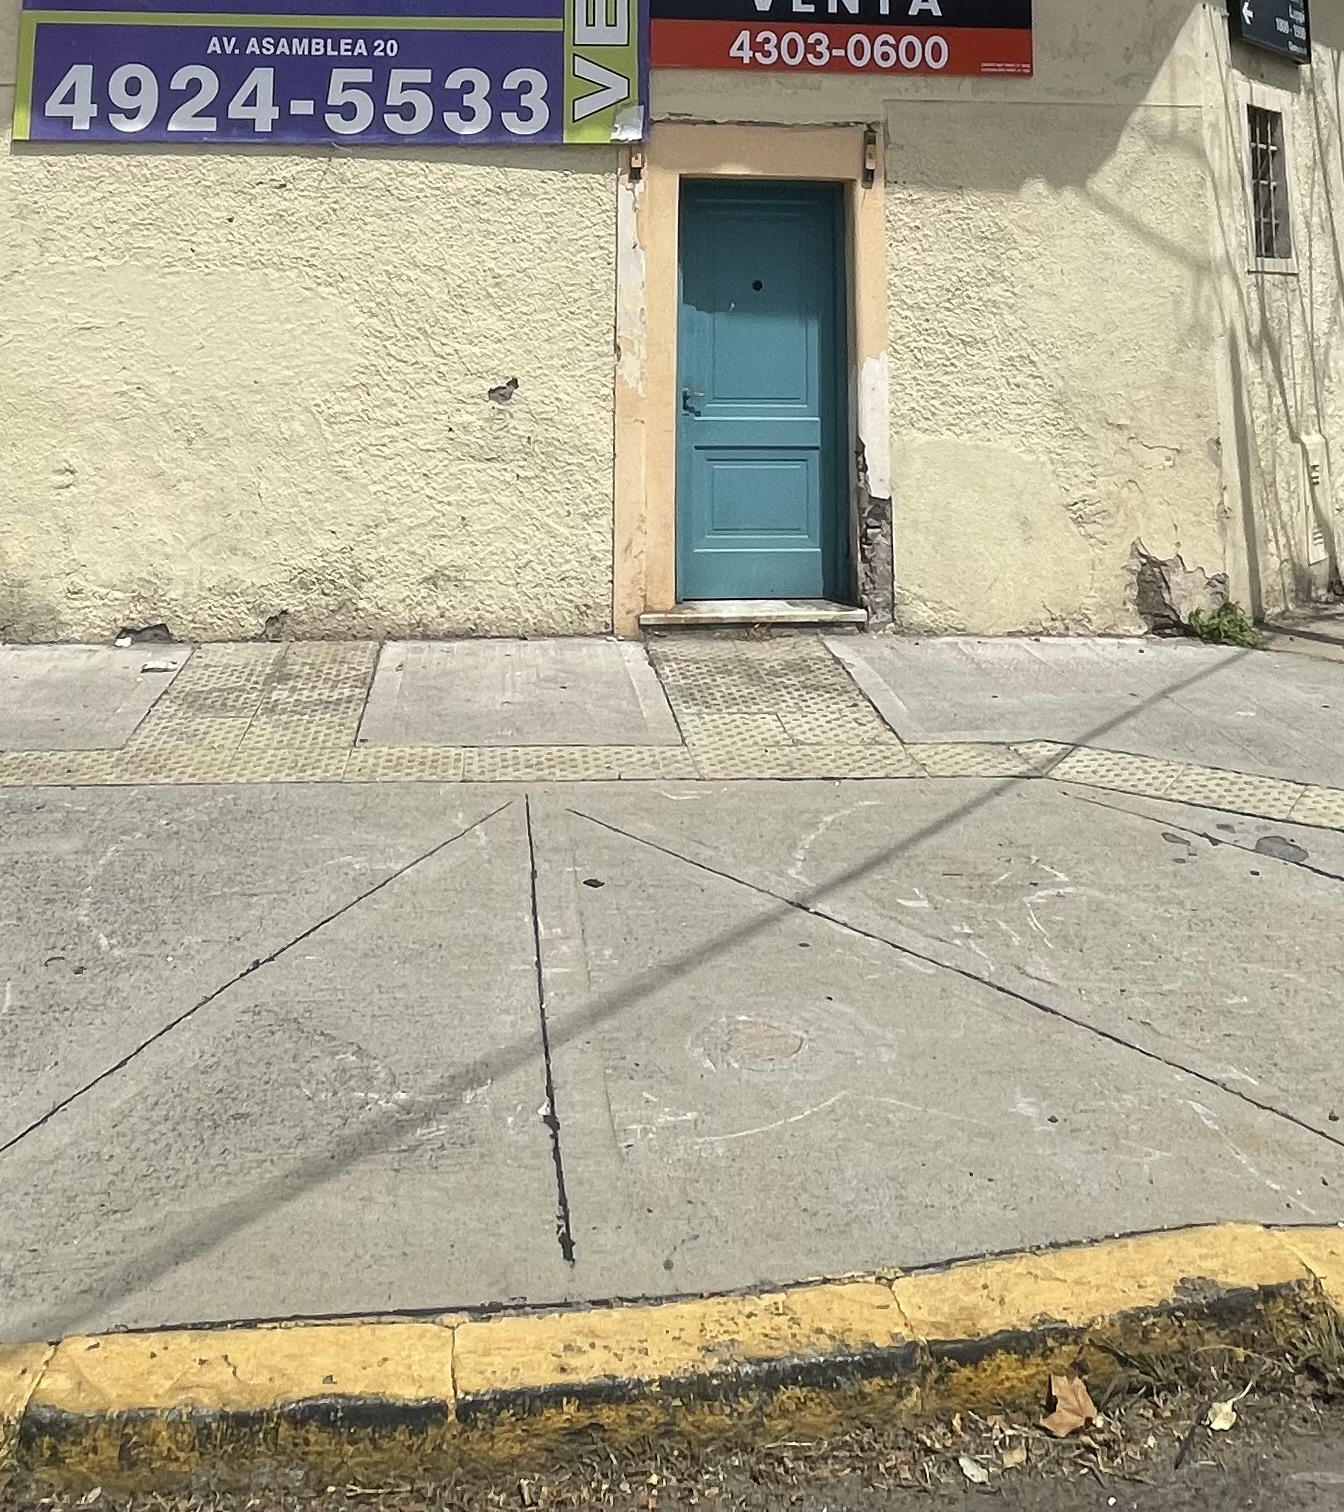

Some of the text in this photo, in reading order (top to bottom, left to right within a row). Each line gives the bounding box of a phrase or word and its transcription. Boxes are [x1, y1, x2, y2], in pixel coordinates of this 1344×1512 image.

[207, 37, 398, 57] AV. ASAMBLEA 20
[729, 30, 949, 70] 4303-0600
[44, 63, 551, 135] 4924-5533
